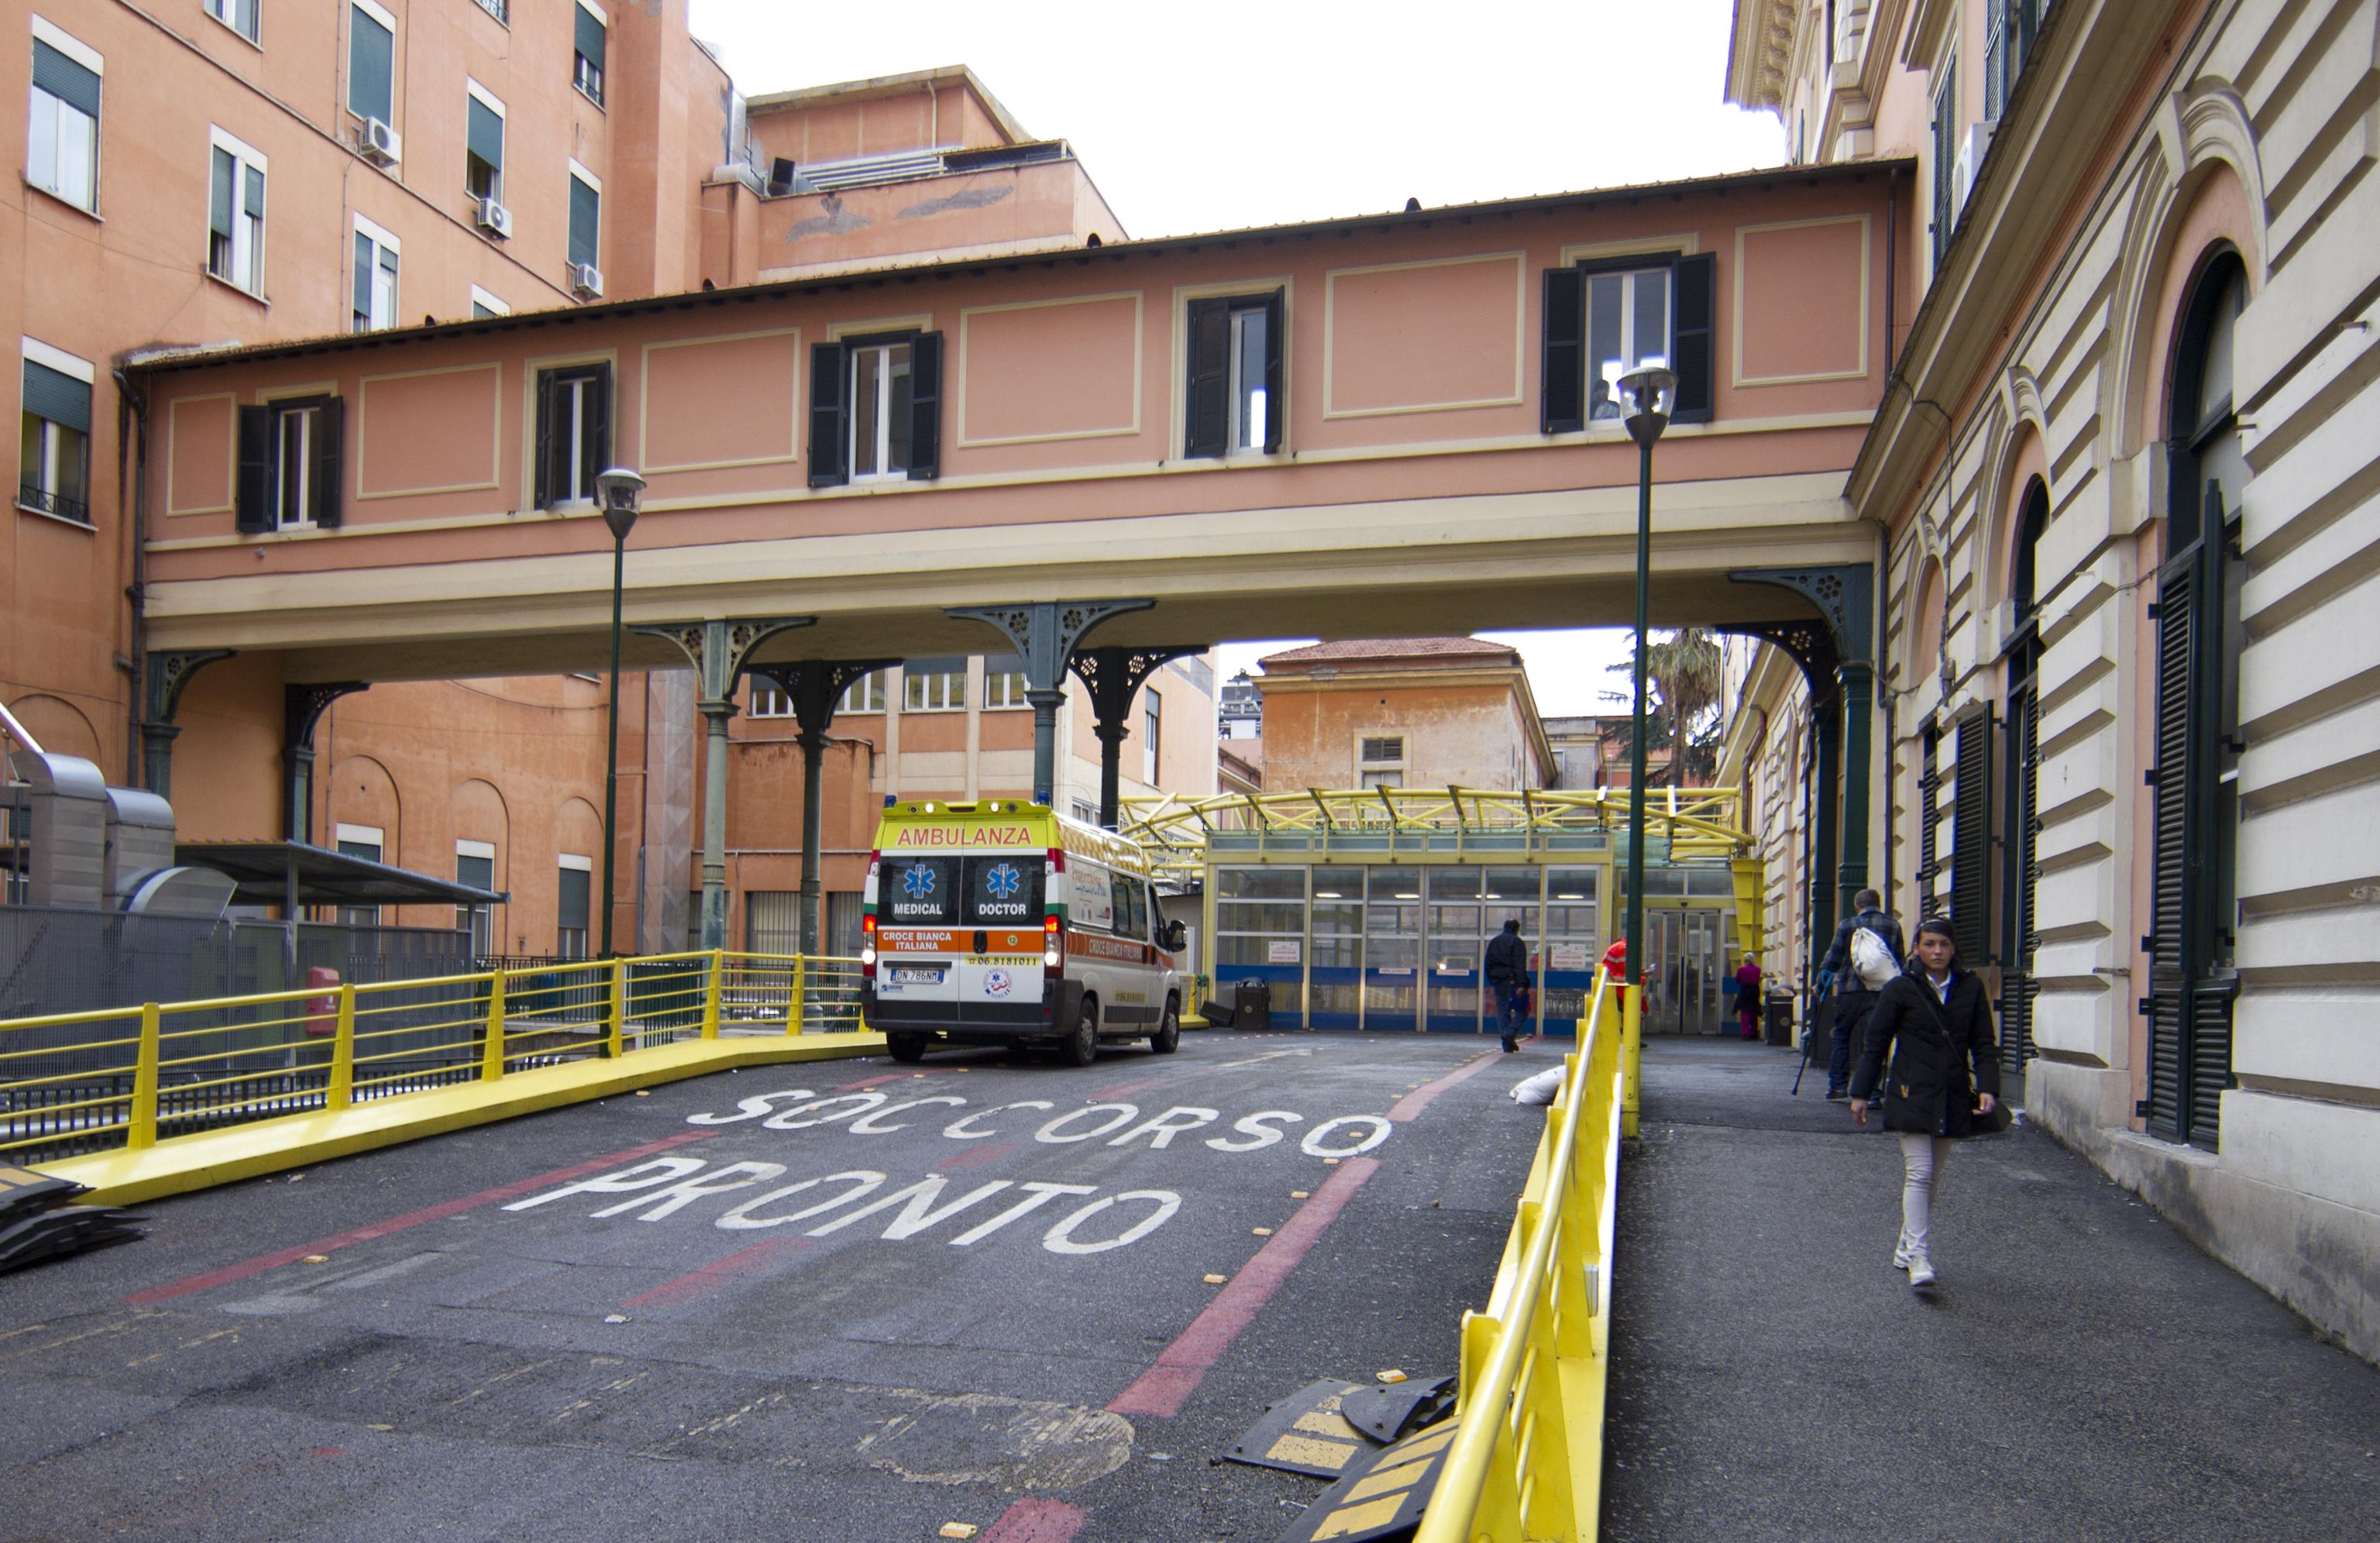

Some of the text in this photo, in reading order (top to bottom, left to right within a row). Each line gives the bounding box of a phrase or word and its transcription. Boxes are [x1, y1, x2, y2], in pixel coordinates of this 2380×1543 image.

[897, 826, 1031, 846] AMBULANZA
[894, 903, 943, 915] MEDICAL
[978, 903, 1027, 915] DOCTOR
[882, 932, 952, 941] CROCE BIANCA
[896, 941, 938, 950] ITALIANA
[897, 971, 908, 980] DN
[686, 1090, 1391, 1157] SOCCORSO
[500, 1157, 1181, 1254] PRONTO
